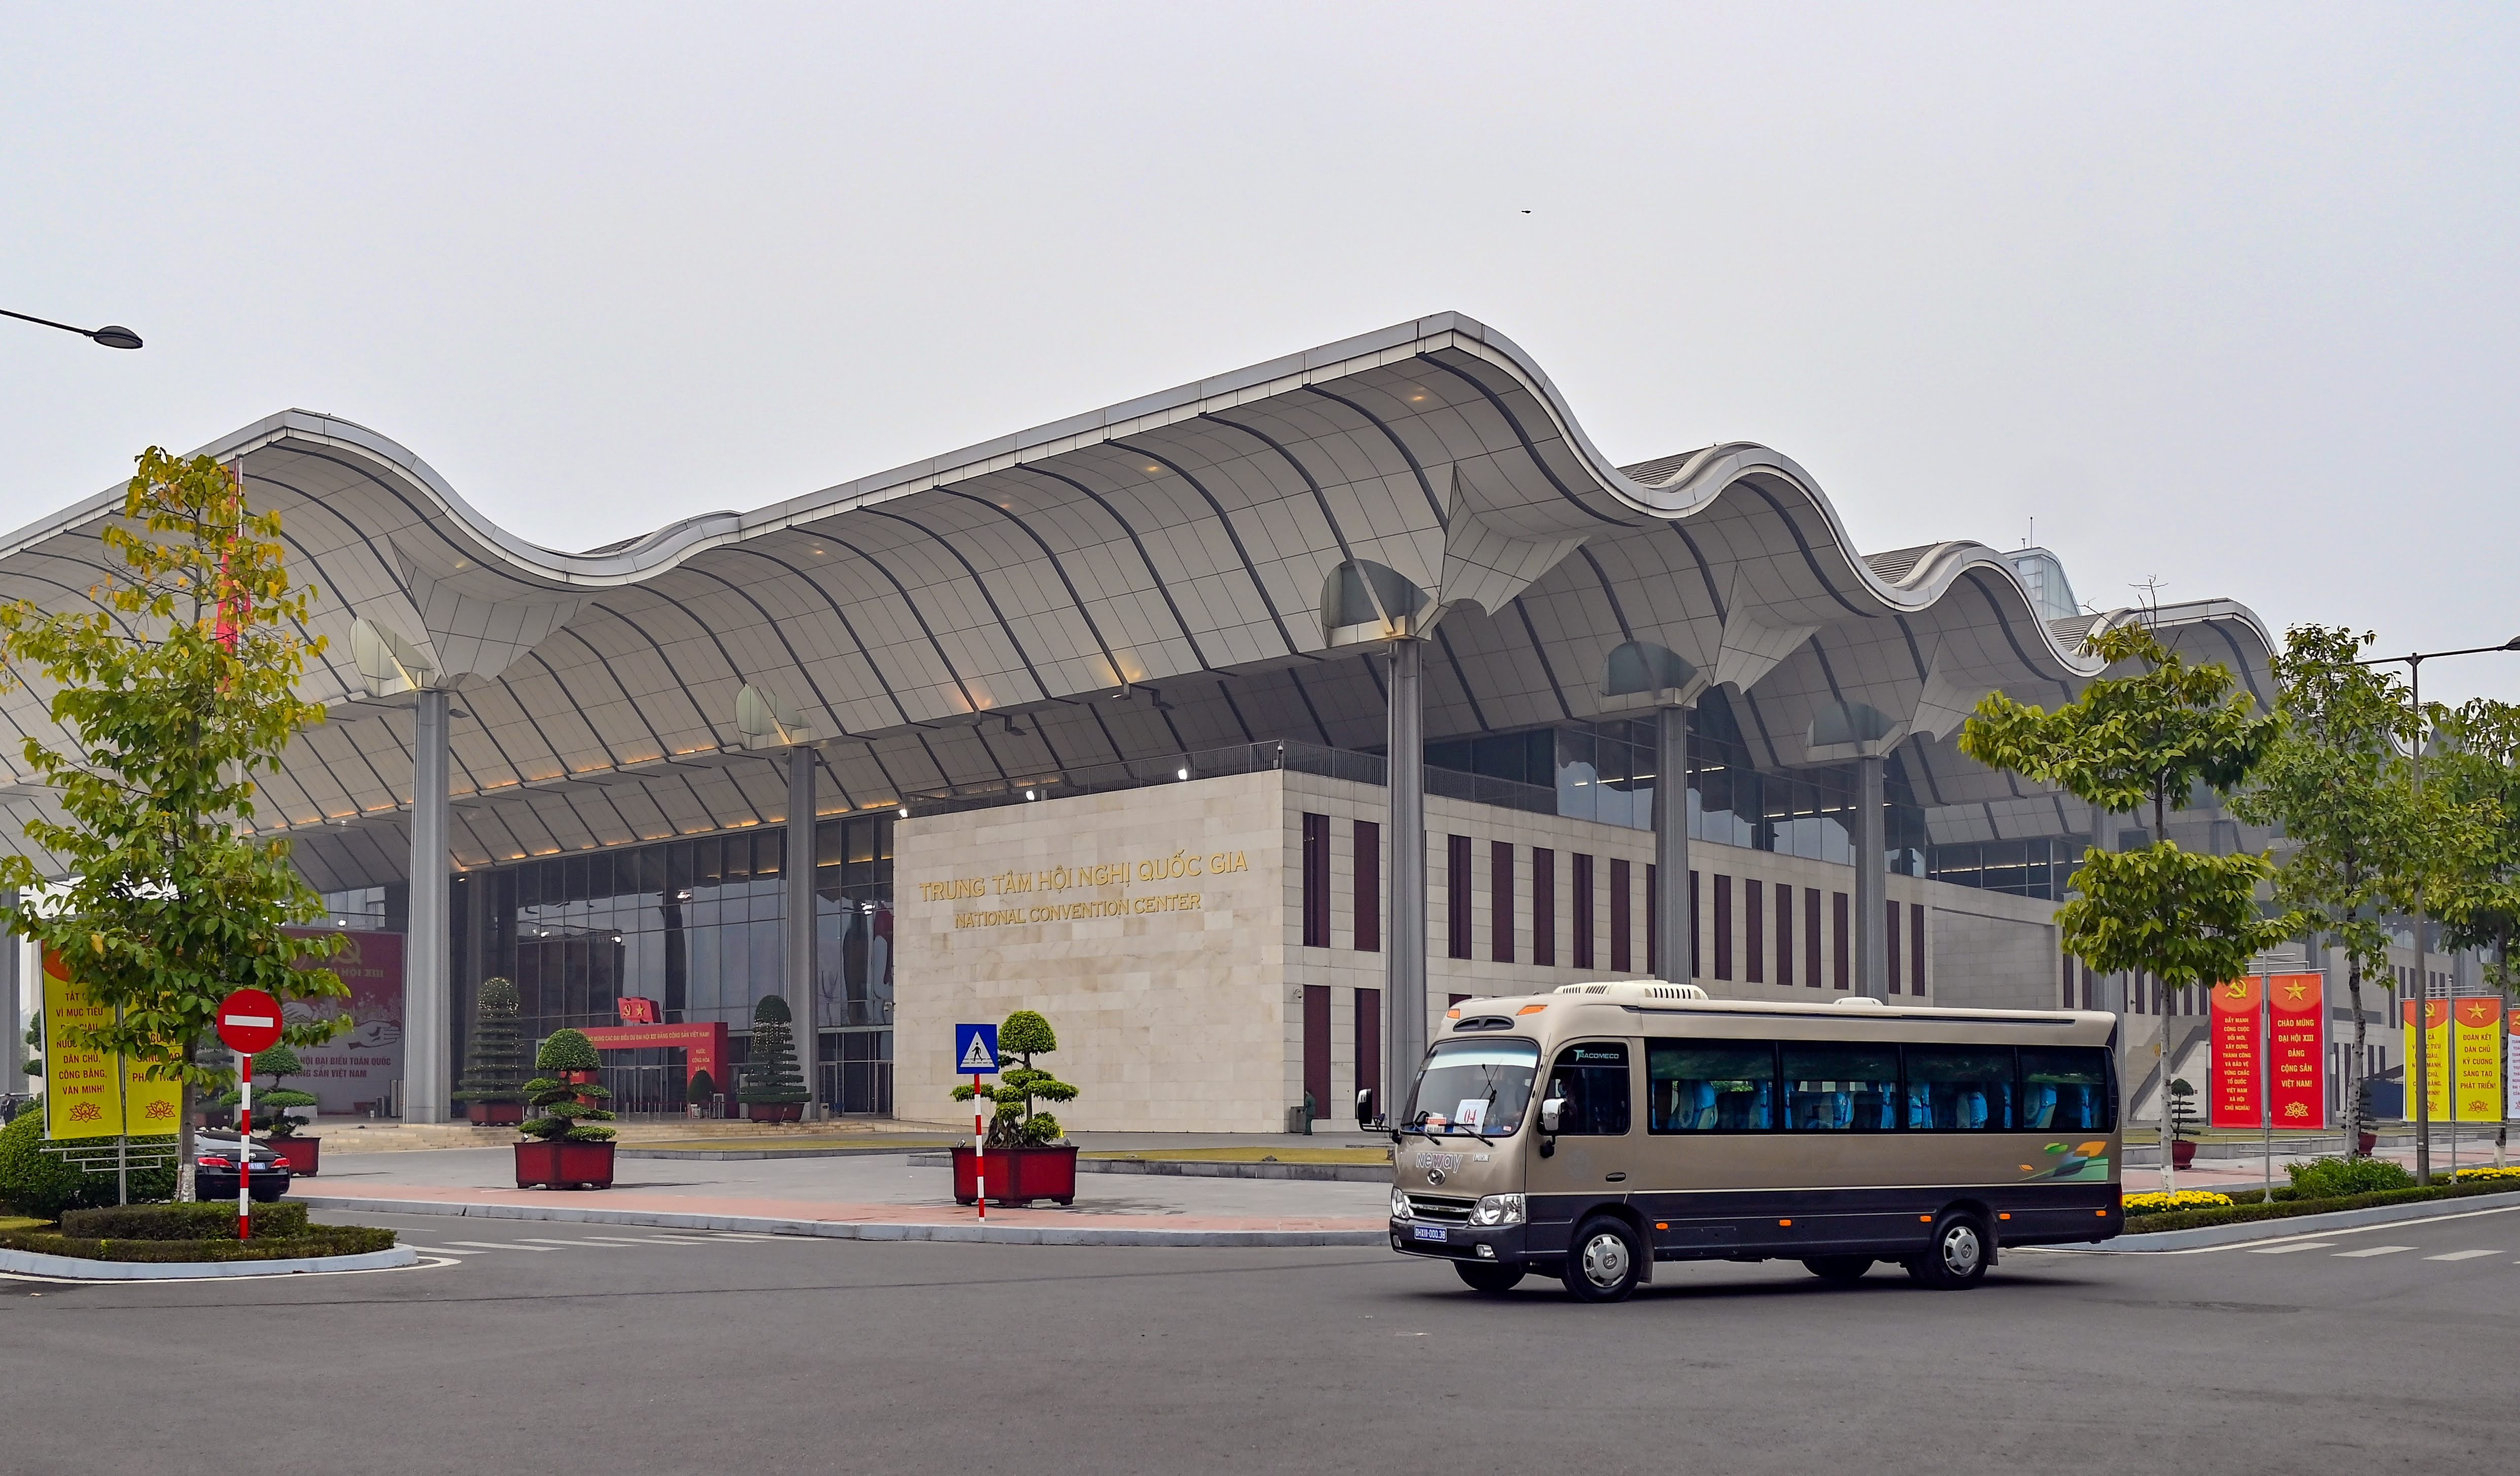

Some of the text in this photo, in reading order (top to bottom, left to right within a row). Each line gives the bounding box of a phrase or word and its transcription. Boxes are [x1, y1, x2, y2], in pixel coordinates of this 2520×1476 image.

[919, 849, 1249, 902] TRUNG TÂM HỘI NGHỊ QUỐC GIA
[955, 893, 1201, 929] NATIONAL CONVENTION CENTER
[2277, 1018, 2294, 1027] CHÀO
[2291, 1034, 2301, 1043] HỘI
[1573, 1049, 1619, 1062] TRACOMECO
[59, 1069, 80, 1079] CÔNG
[2281, 1064, 2298, 1074] CỘNG
[2282, 1079, 2294, 1088] VIỆT
[82, 1085, 105, 1094] MINH!
